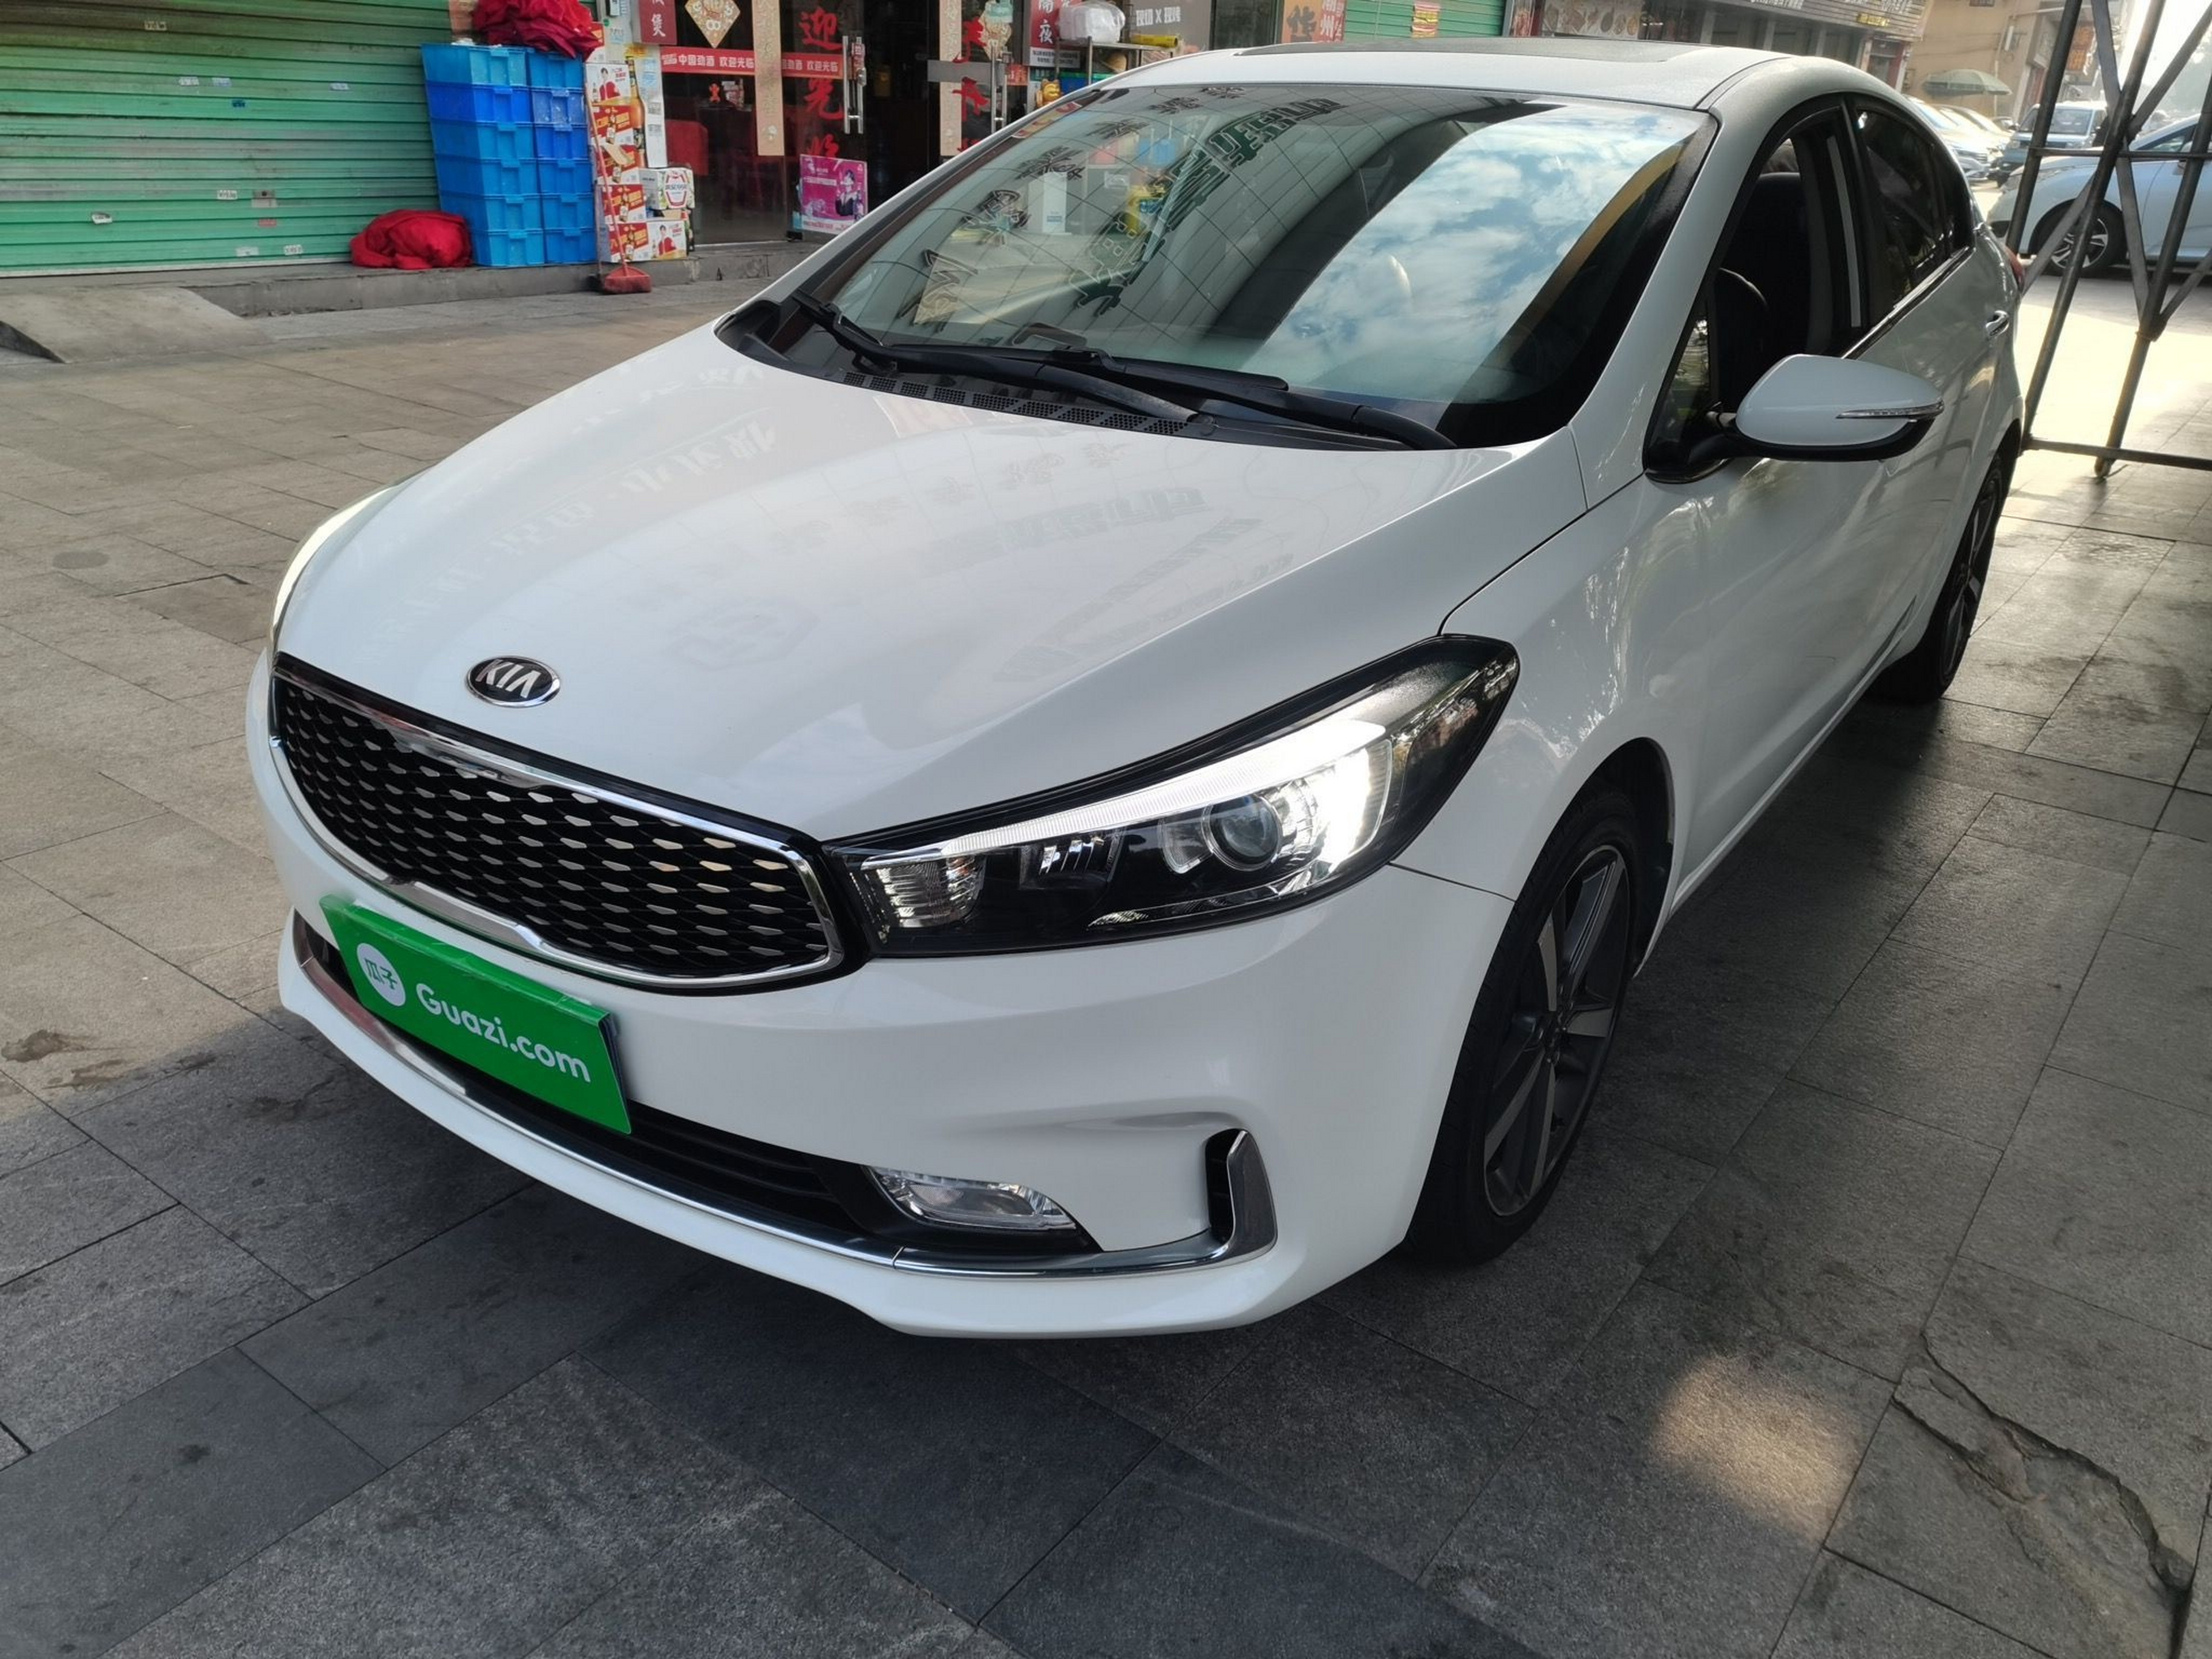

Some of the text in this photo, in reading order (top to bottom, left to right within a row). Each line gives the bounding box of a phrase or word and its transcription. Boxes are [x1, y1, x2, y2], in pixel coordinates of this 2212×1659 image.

[719, 56, 755, 69] 欢迎光临
[806, 60, 838, 72] 欢迎光临
[475, 659, 541, 698] KIA
[363, 956, 398, 989] 瓜子
[416, 983, 591, 1083] Guazi.com
